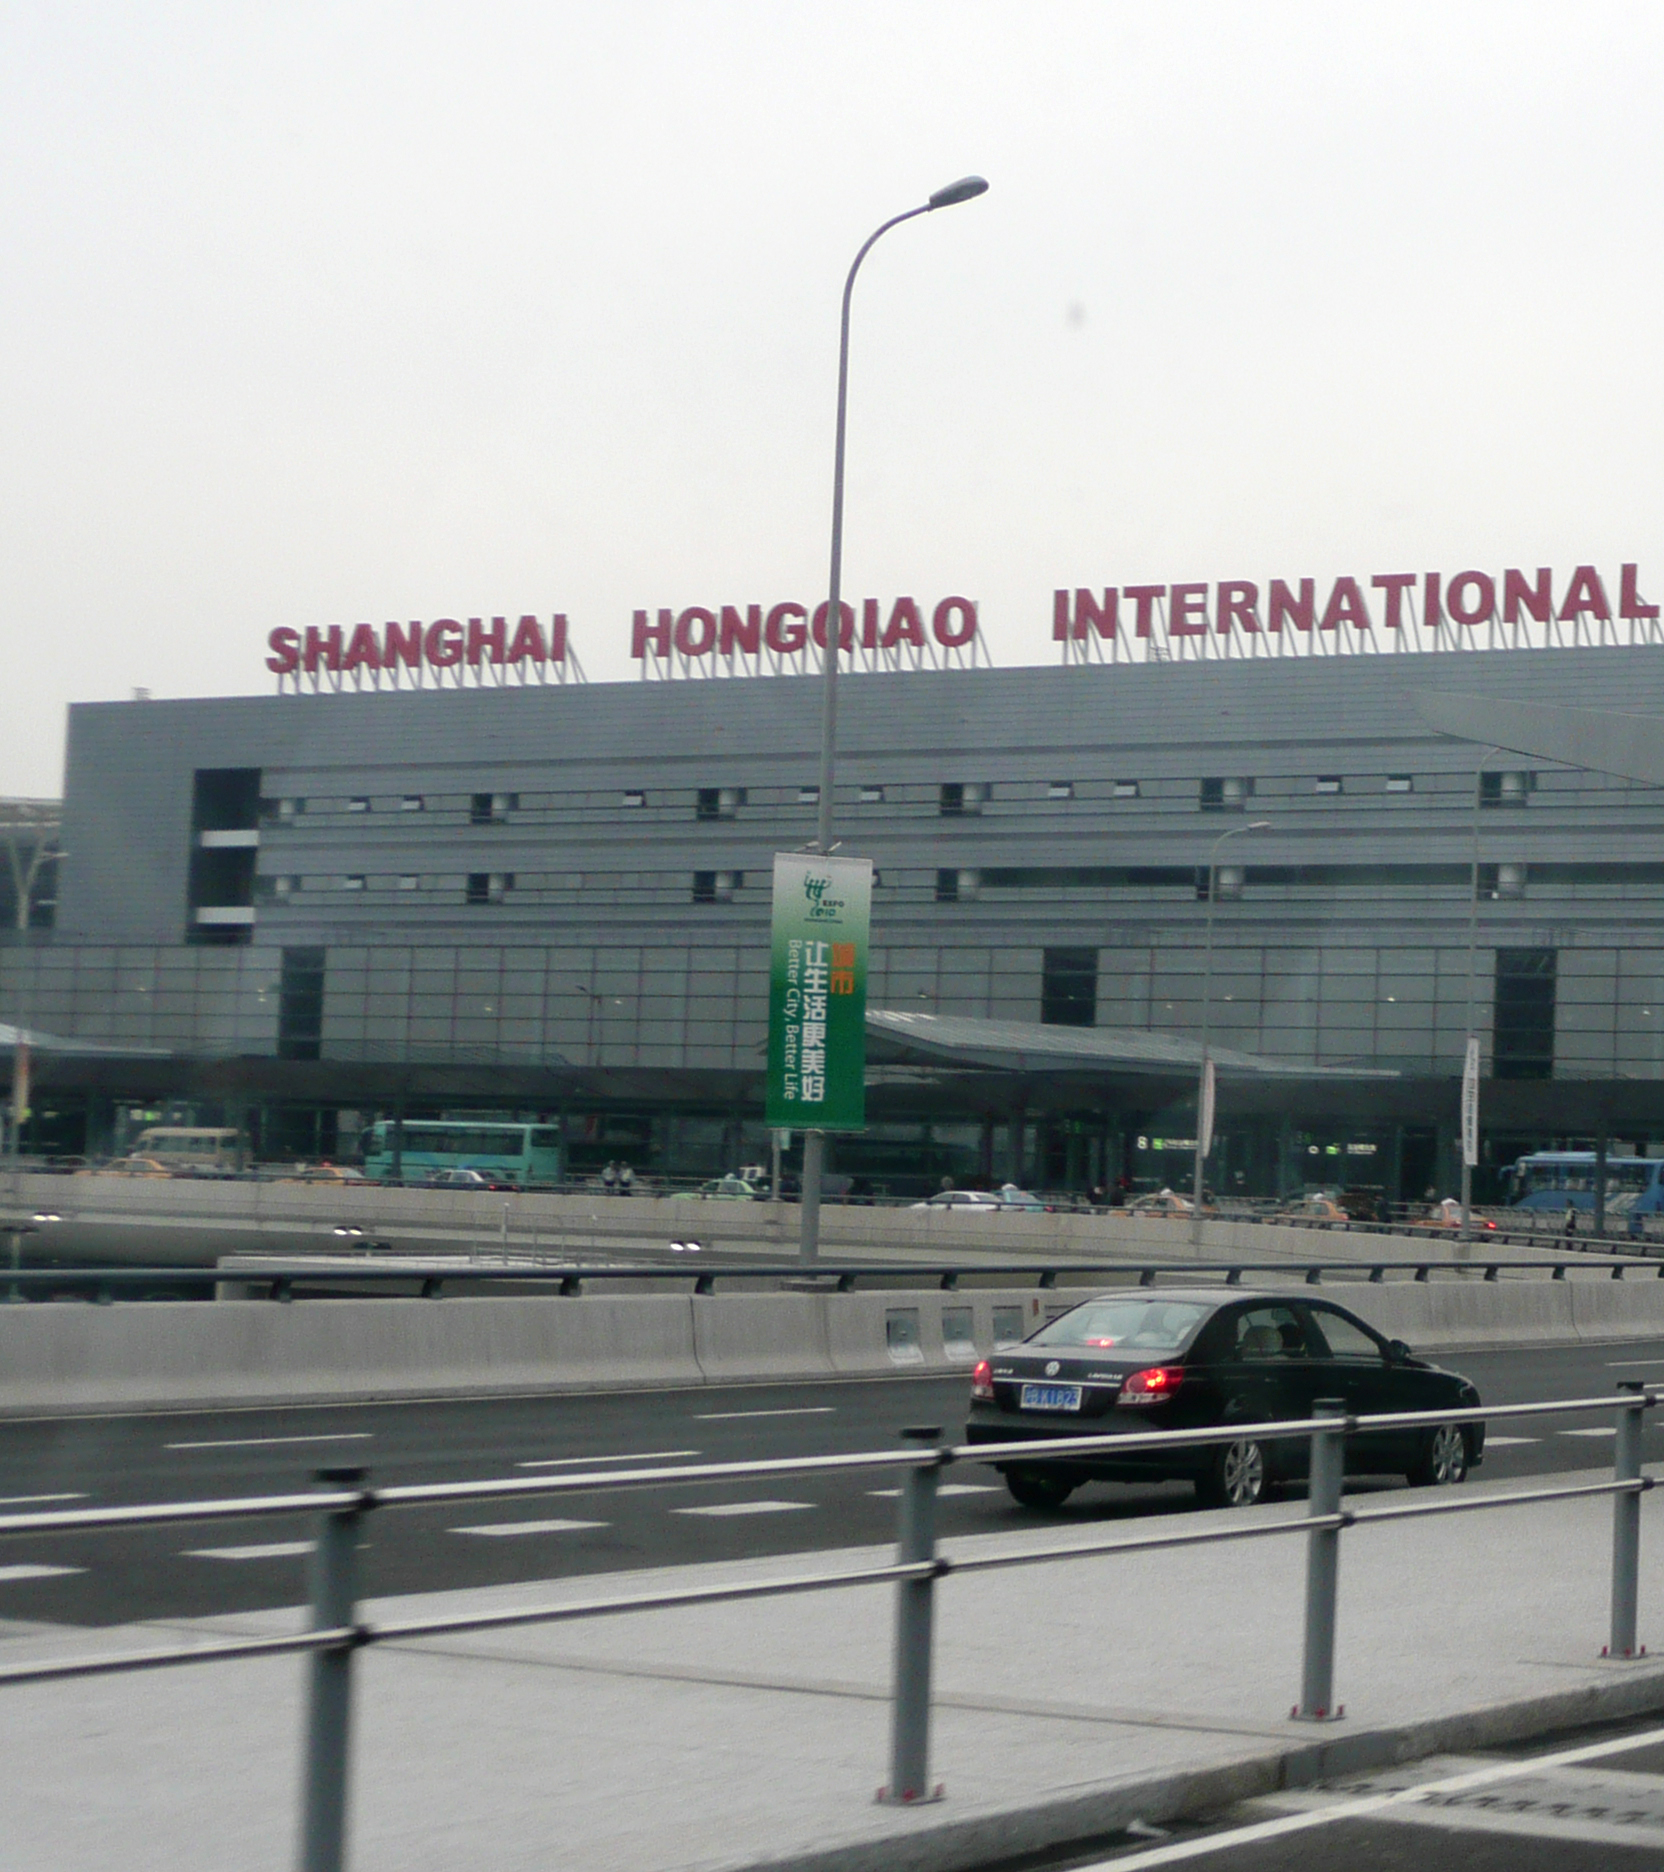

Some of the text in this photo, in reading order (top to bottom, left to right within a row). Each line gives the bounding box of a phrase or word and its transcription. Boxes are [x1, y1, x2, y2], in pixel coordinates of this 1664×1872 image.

[266, 613, 567, 673] SHANGHAI
[632, 596, 979, 659] HONGQIAO
[1052, 562, 1661, 641] INTERNATIONAL
[784, 939, 803, 1100] Better City, Better Life
[800, 940, 829, 1102] 让生活更美好
